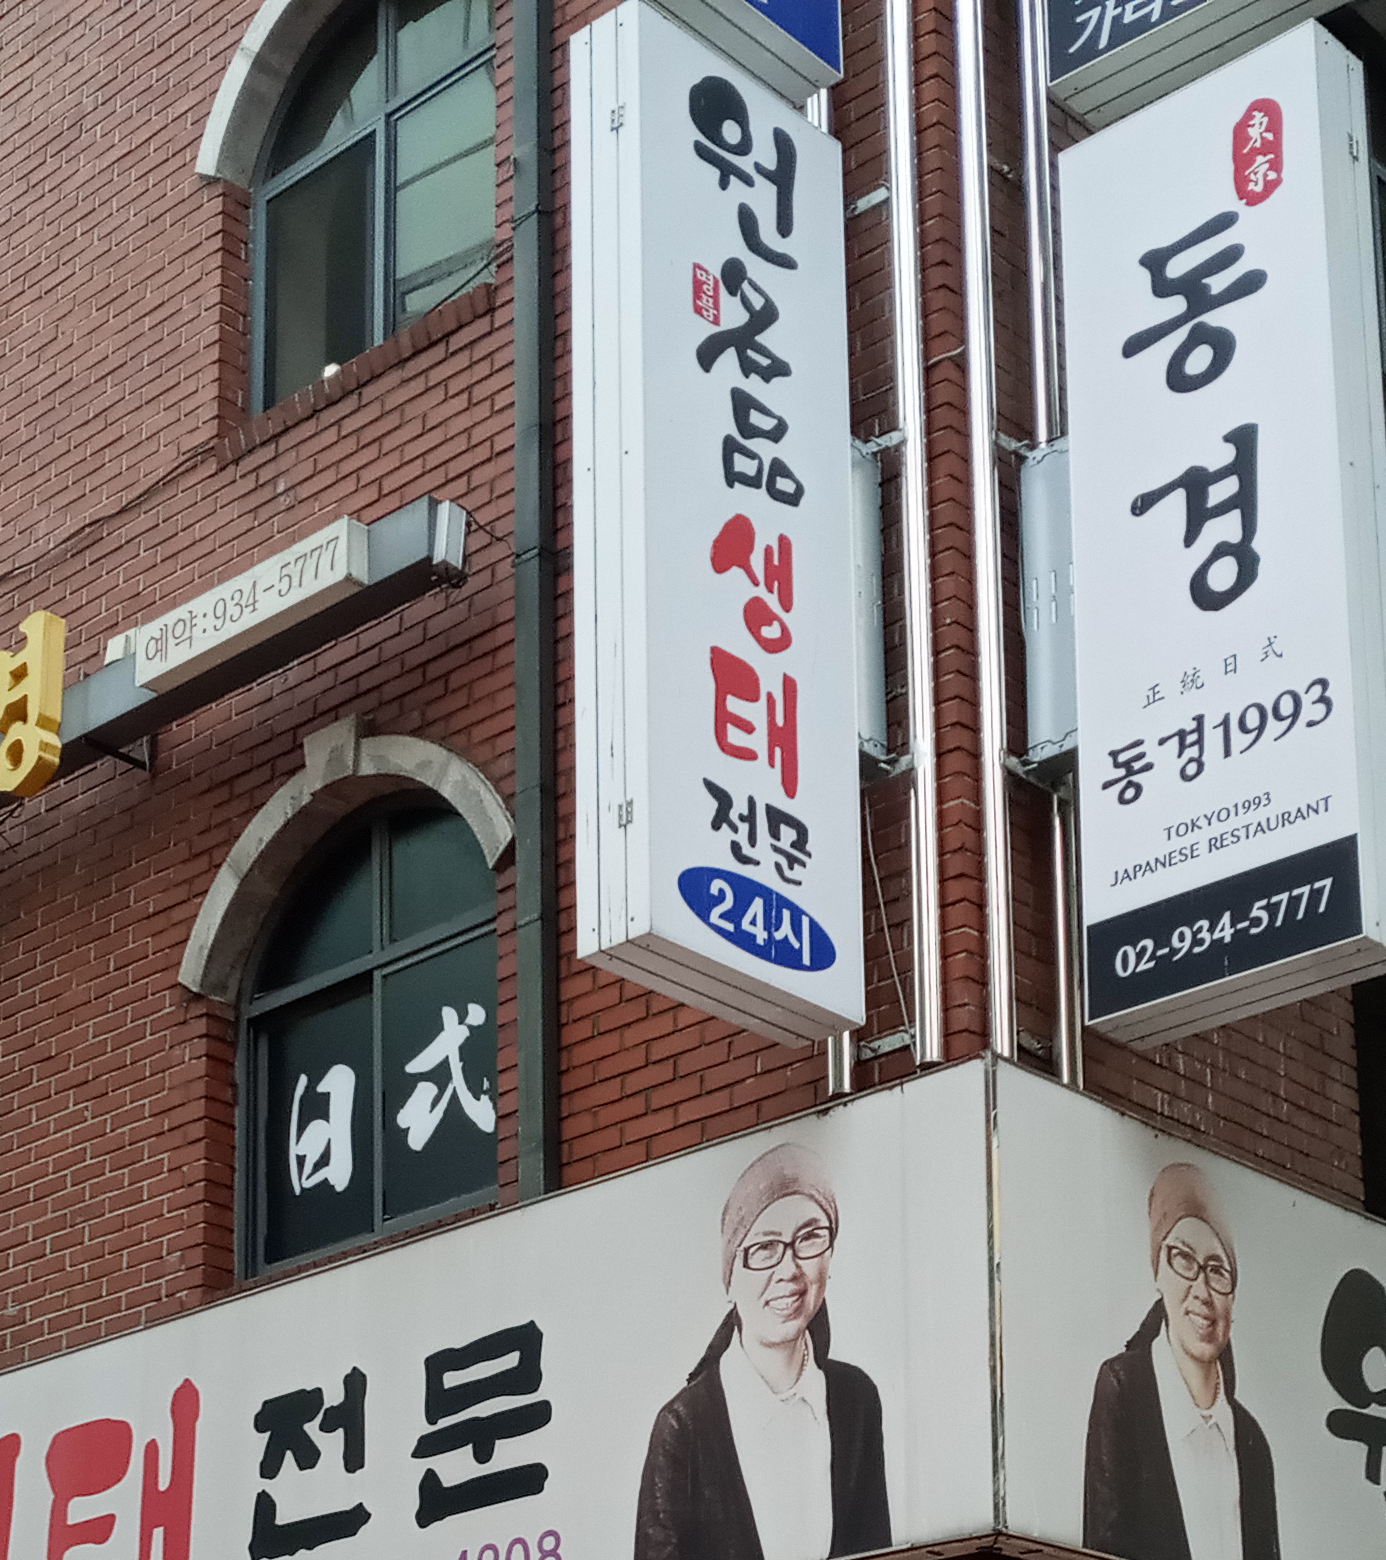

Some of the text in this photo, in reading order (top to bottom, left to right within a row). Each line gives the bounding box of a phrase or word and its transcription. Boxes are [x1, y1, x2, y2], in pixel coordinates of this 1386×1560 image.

[689, 75, 798, 270] 원
[1242, 110, 1278, 193] 東京
[1121, 210, 1268, 612] 동경
[709, 513, 799, 800] 생태
[1141, 635, 1284, 709] 正統日式
[1101, 676, 1334, 806] 동경1993
[702, 776, 811, 886] 전문
[1110, 795, 1333, 887] JAPANESE RESTAURANT
[1162, 791, 1272, 842] TOKYO1993
[708, 877, 811, 967] 24시
[1114, 876, 1334, 979] 02-934-5777
[287, 1003, 498, 1195] 日式
